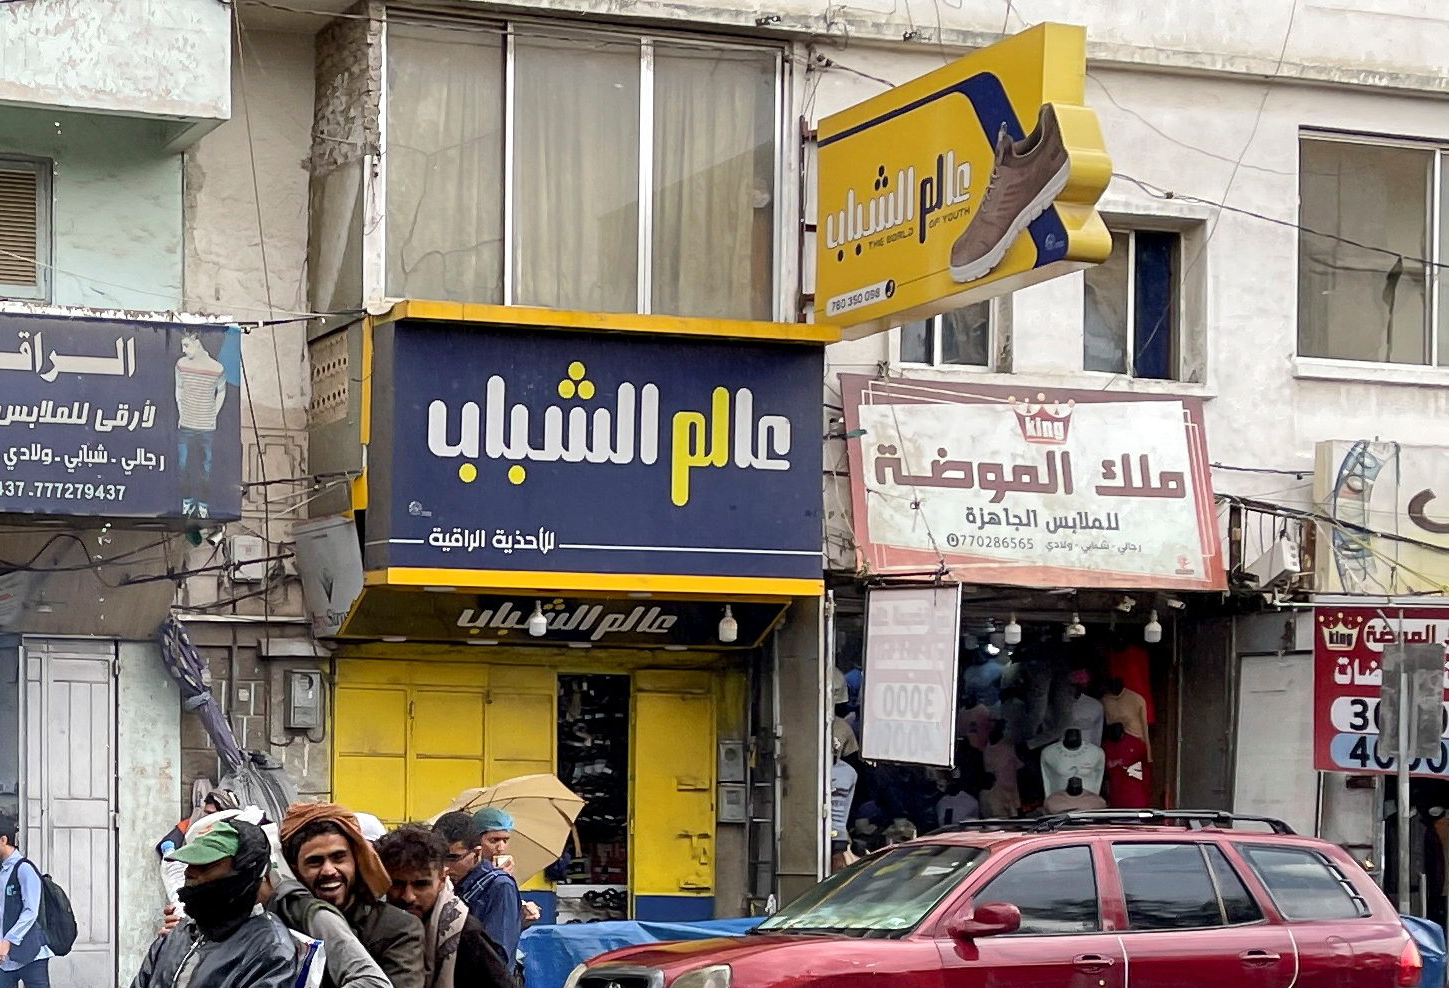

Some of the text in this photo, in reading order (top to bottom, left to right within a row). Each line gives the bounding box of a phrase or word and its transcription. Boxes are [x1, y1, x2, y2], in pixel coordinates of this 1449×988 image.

[826, 150, 971, 262] عالم الشباب
[942, 206, 971, 223] YOUTH
[427, 361, 791, 507] عالم الشباب
[1024, 416, 1065, 441] king
[3, 443, 53, 470] ولادي
[63, 444, 108, 473] شبابي
[120, 448, 166, 475] رجالي
[874, 444, 1186, 504] ملك الموضة
[965, 506, 1120, 534] للملابس الجاهزة
[428, 527, 555, 555] للأحذية الراقية
[457, 598, 678, 641] عالم الشباب
[1328, 631, 1354, 647] king
